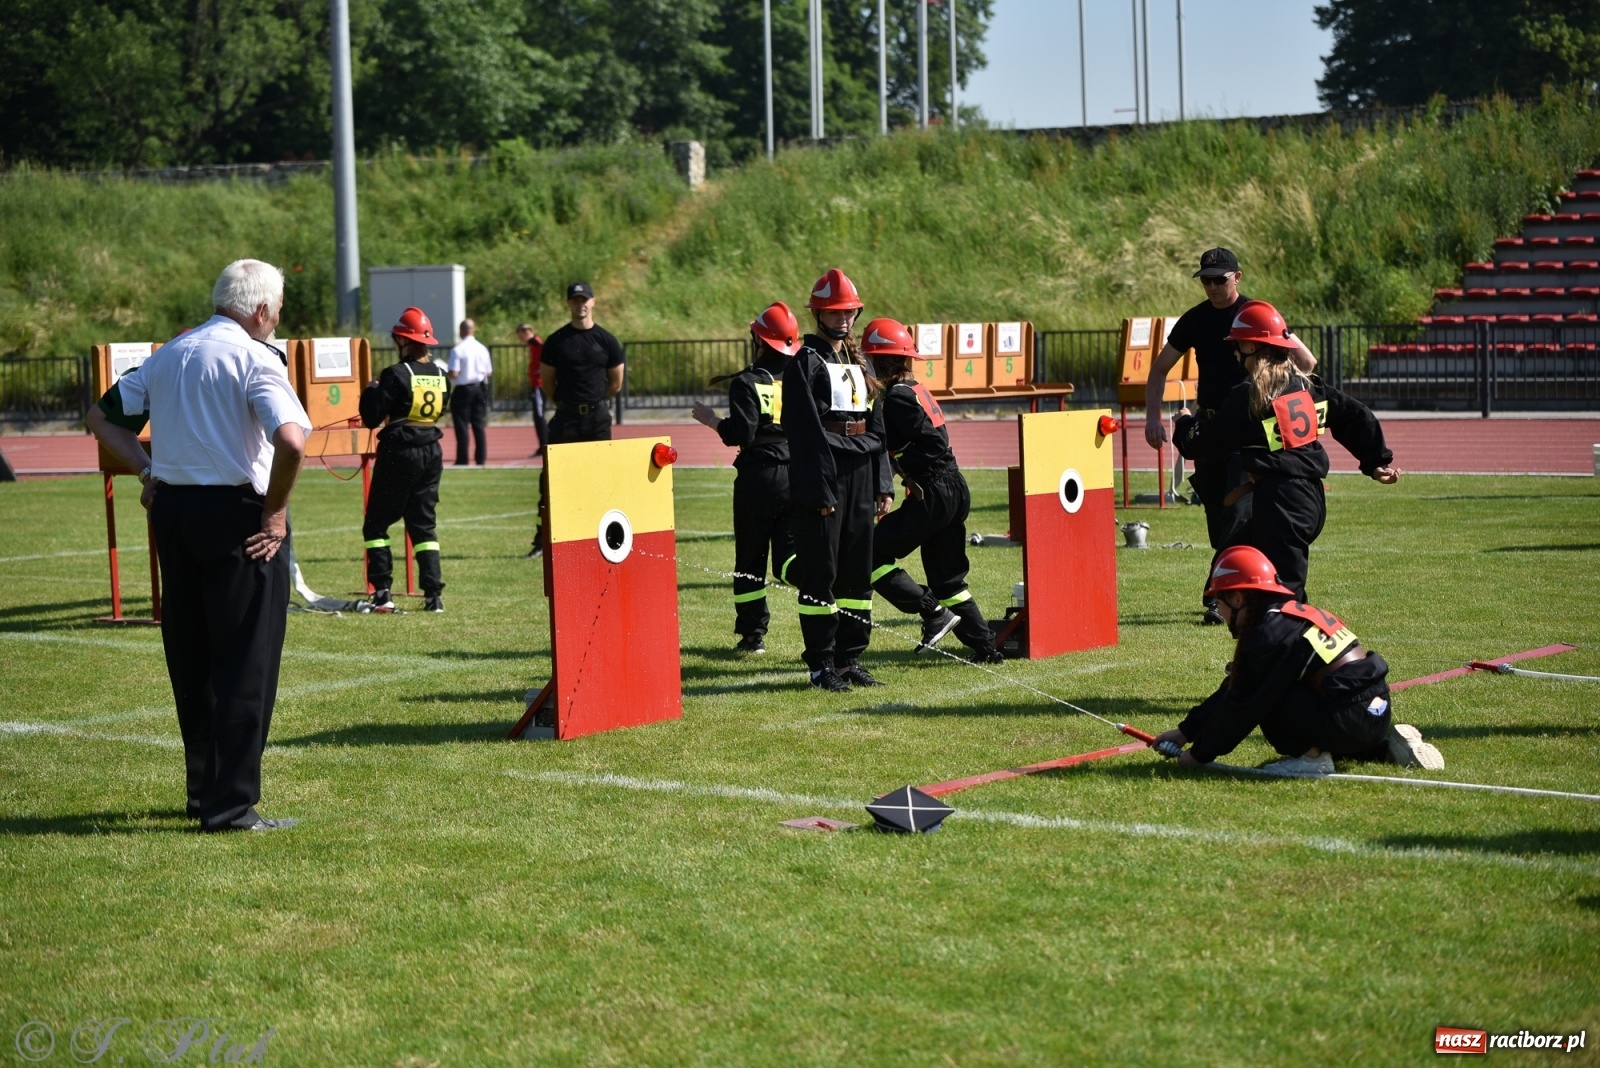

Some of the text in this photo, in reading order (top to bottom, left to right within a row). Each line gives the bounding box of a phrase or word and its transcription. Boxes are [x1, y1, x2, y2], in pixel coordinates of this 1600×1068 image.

[926, 361, 933, 378] 3
[965, 360, 973, 376] 4
[1006, 357, 1013, 374] 5
[1133, 351, 1142, 371] 6
[328, 384, 341, 406] 9
[419, 390, 436, 418] 8
[1287, 397, 1311, 438] 5
